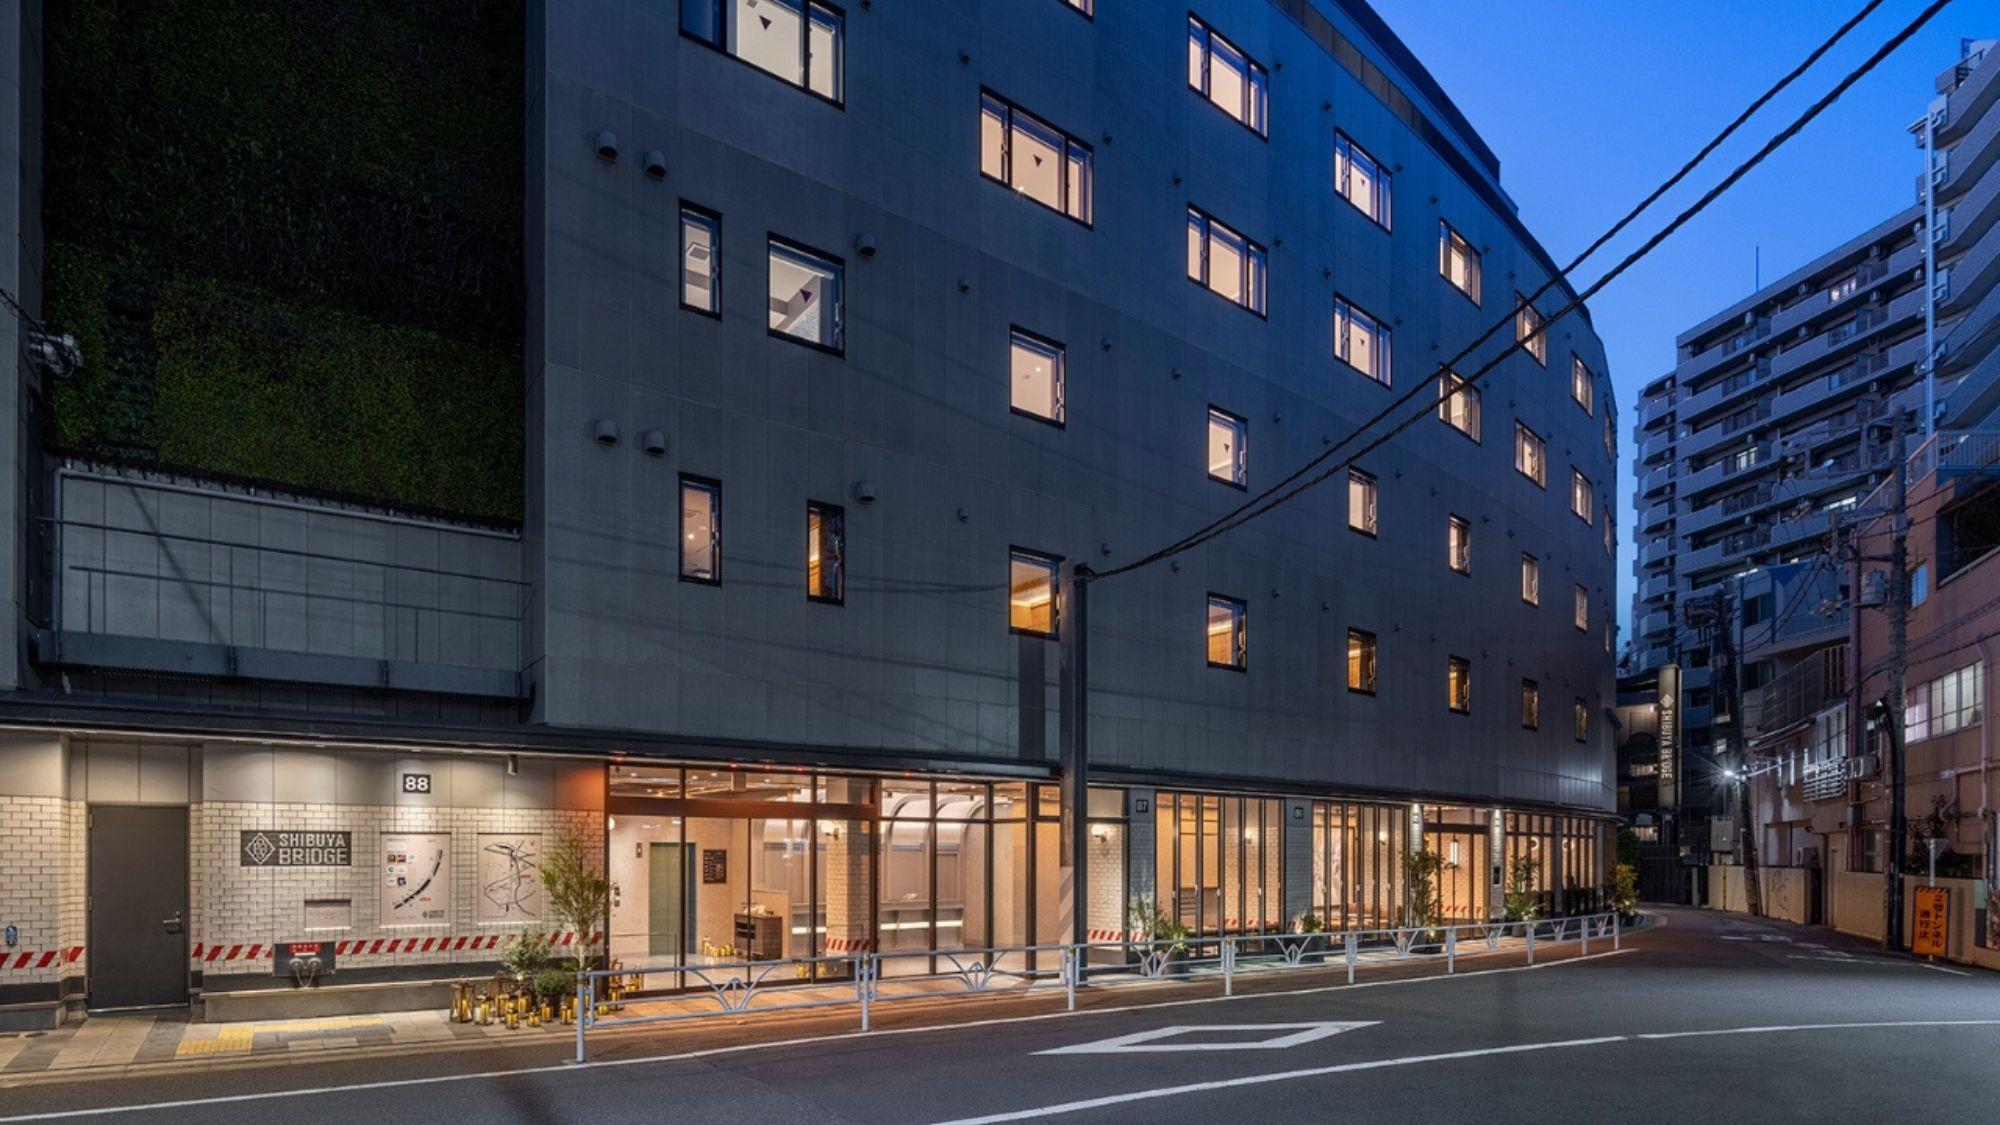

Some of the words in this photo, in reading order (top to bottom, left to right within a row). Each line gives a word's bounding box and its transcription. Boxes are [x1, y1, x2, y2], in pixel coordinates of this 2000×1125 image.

[405, 776, 428, 791] 88
[279, 833, 346, 847] SHIBUYA
[279, 849, 347, 864] BRIDGE
